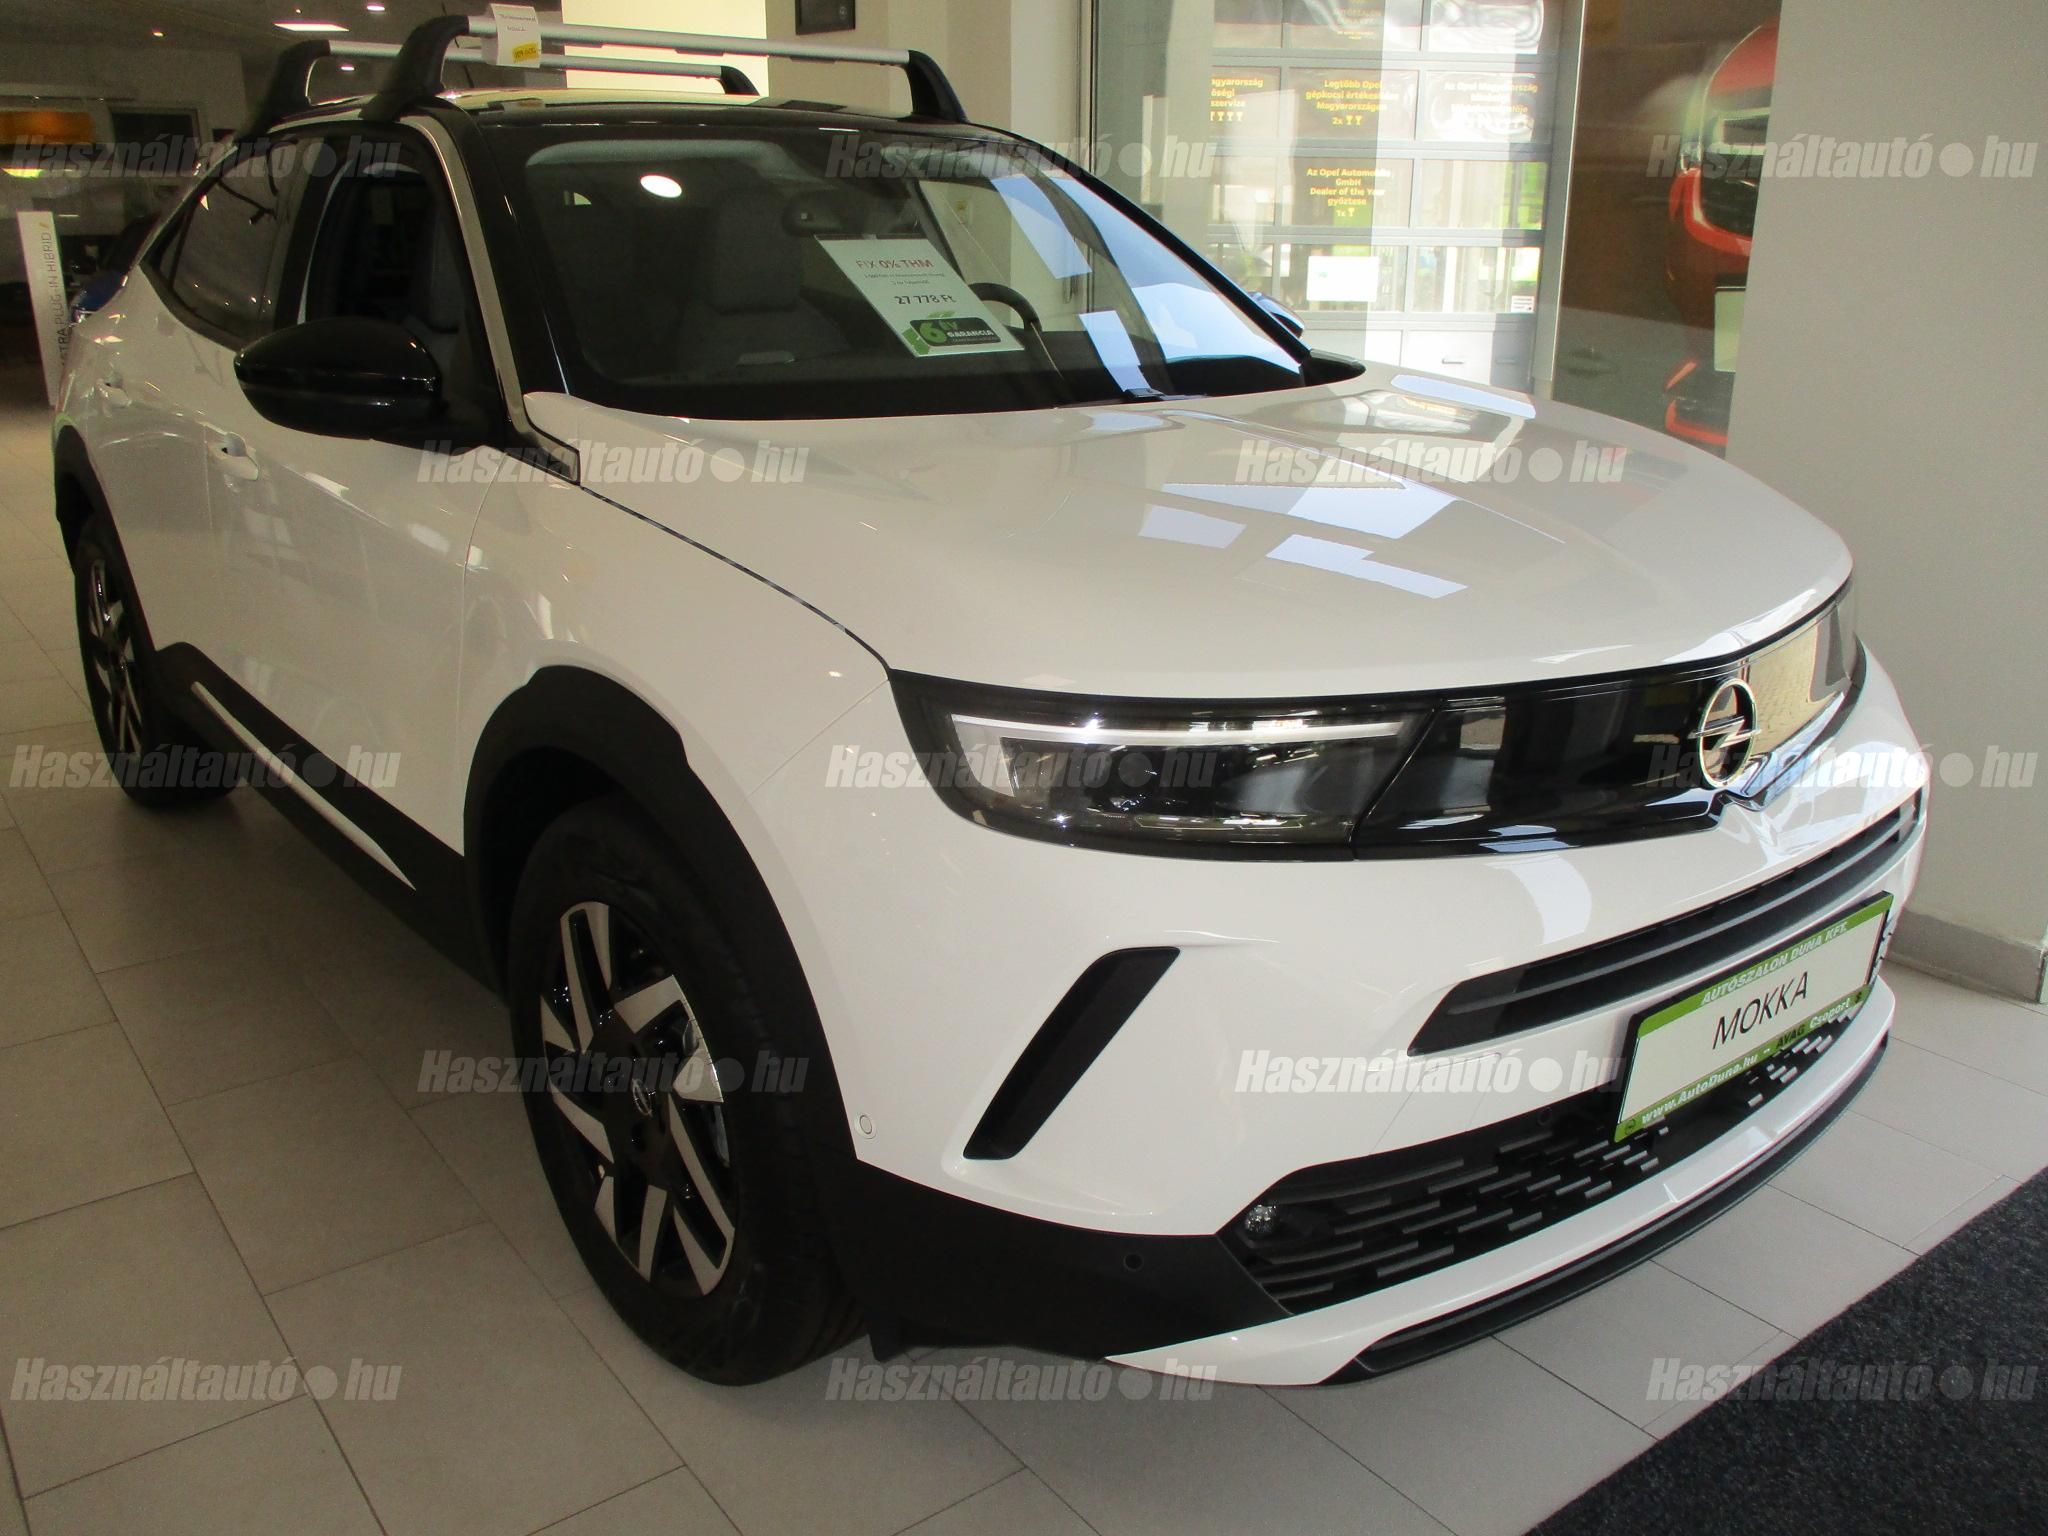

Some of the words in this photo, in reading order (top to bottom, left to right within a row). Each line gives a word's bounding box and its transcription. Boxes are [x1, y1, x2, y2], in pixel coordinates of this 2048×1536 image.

[41, 232, 57, 272] HIBRID
[901, 259, 935, 269] THM
[894, 296, 911, 305] 27
[939, 294, 957, 303] Ft
[1701, 952, 1789, 1006] AUTÓSZALON
[1790, 935, 1823, 960] DUNA
[1712, 972, 1808, 1050] MOKKA
[1641, 1053, 1759, 1125] www.AutoDuna.hu
[1775, 1027, 1806, 1050] AVAG
[1809, 997, 1851, 1029] Csoport
